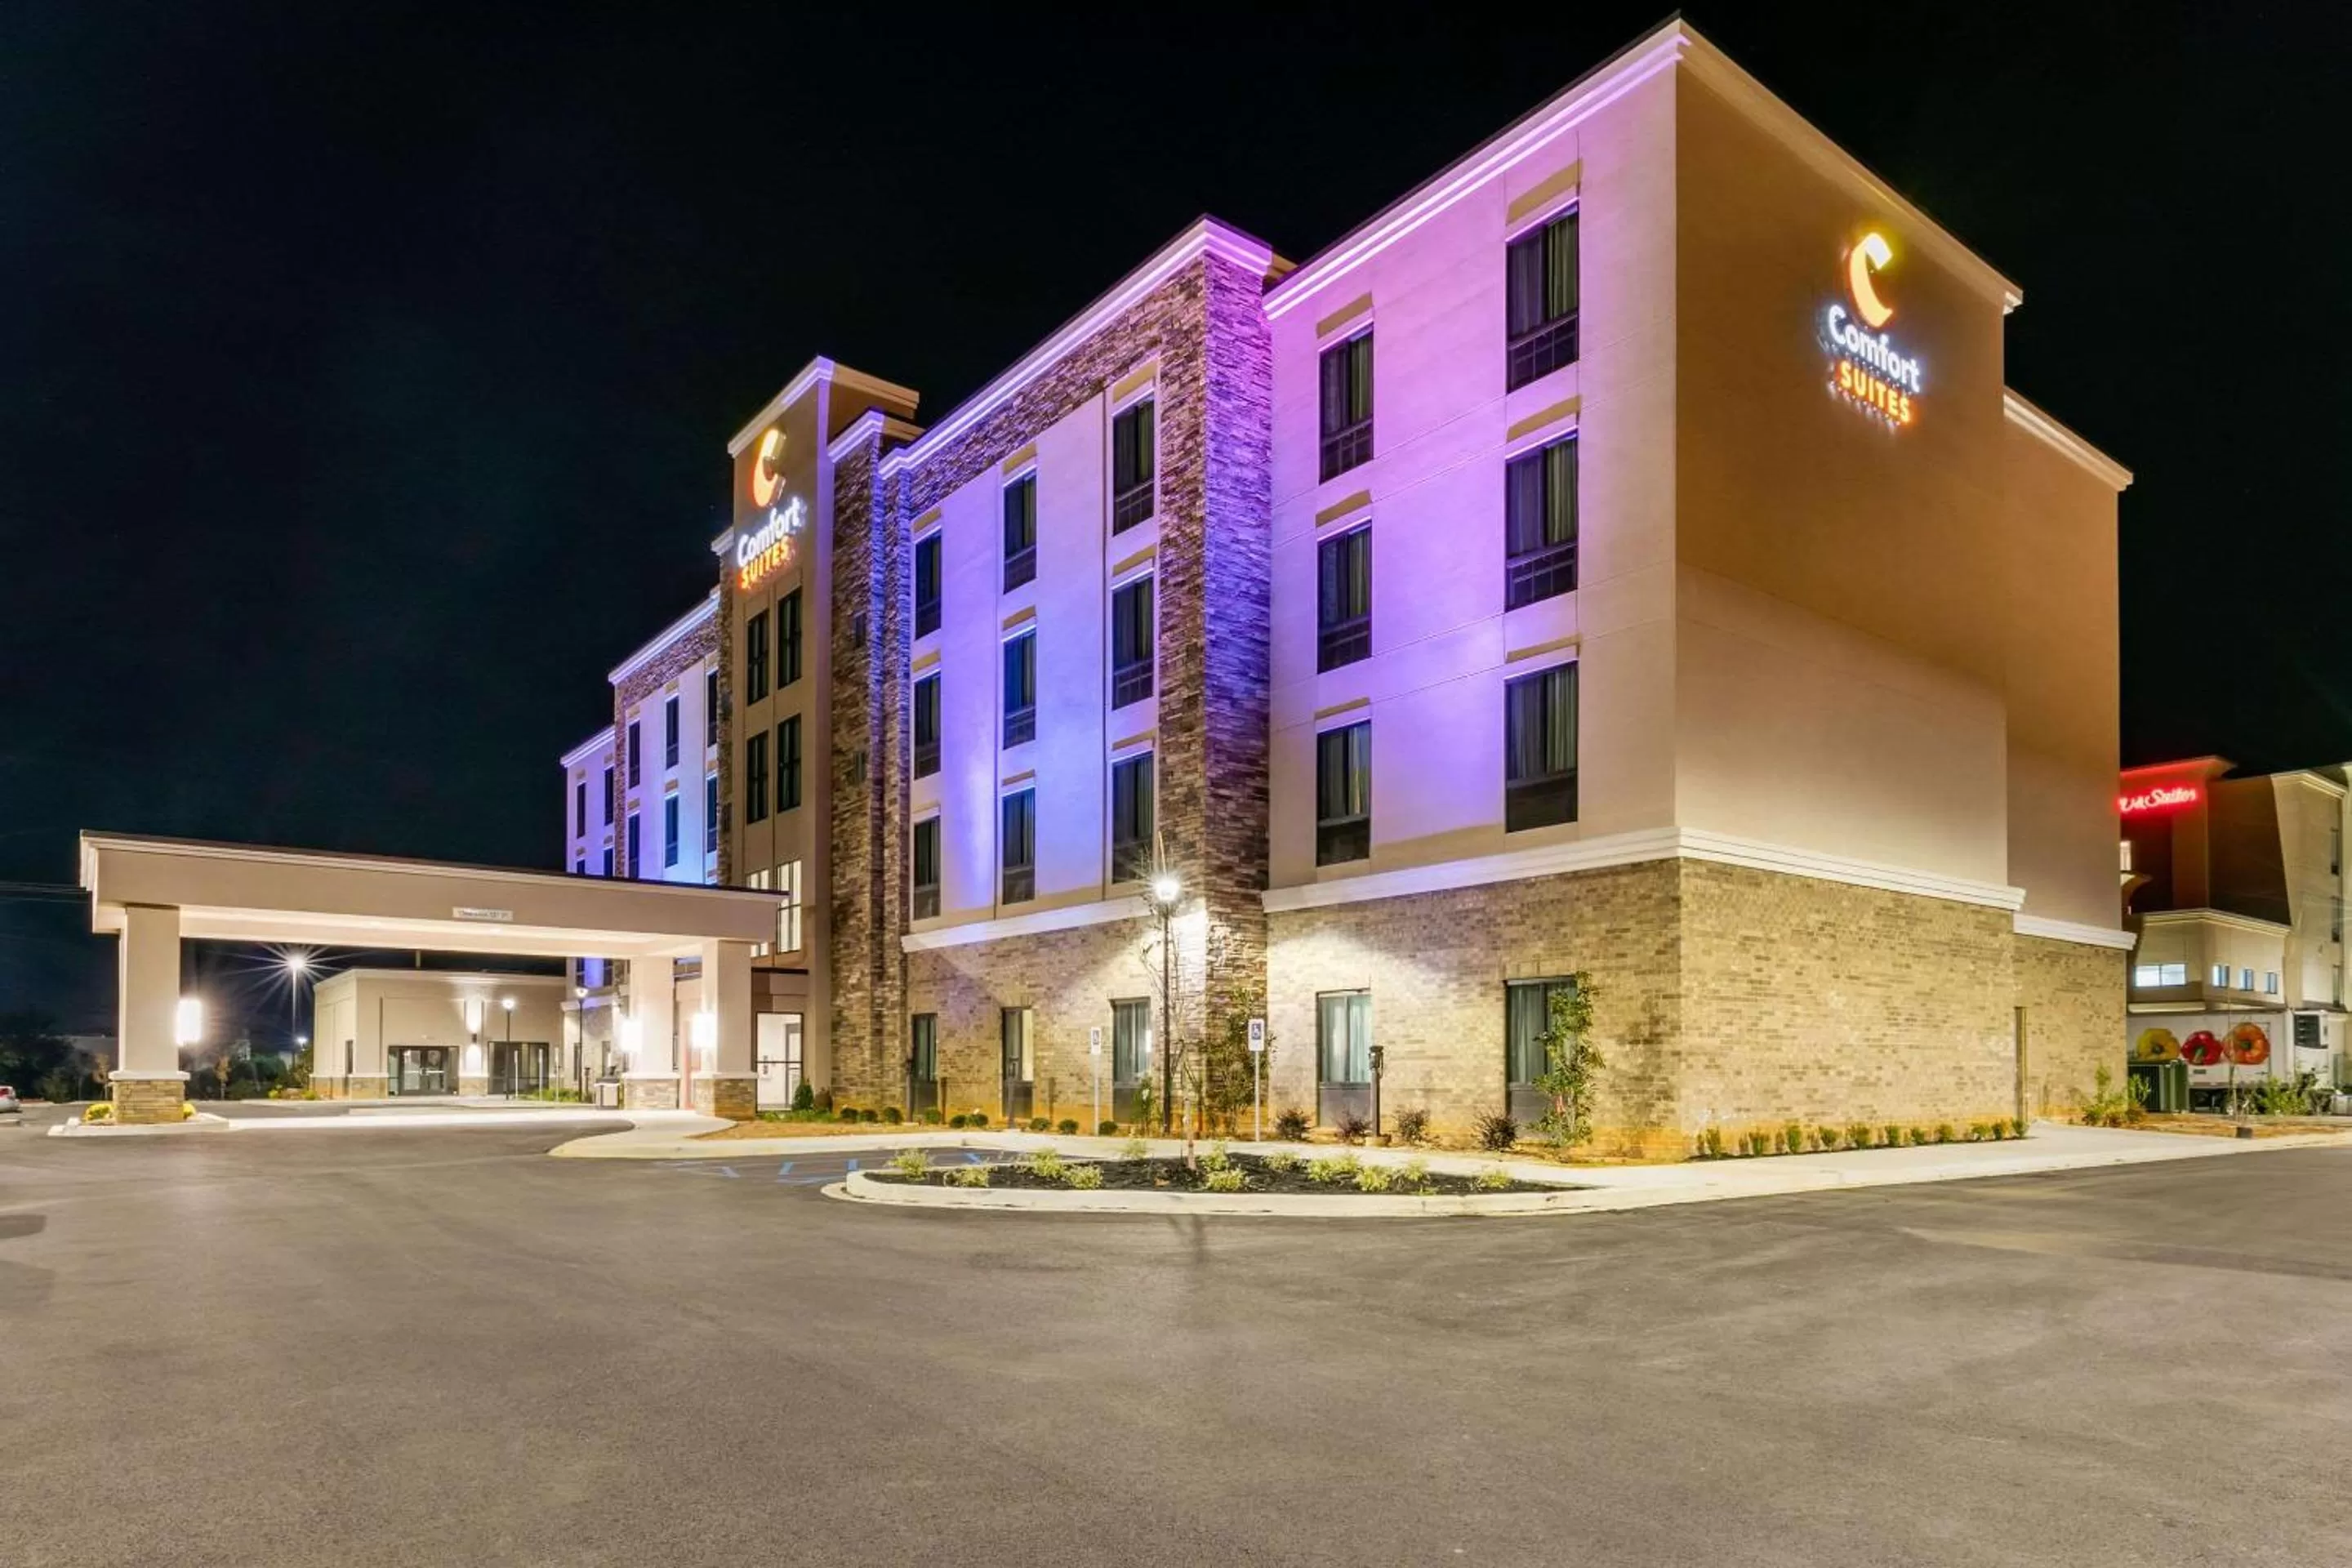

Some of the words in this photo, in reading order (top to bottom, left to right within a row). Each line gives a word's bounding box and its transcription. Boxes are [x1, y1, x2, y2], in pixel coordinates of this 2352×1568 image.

[1828, 304, 1920, 394] Comfort
[1840, 360, 1911, 423] SUITES
[737, 496, 800, 567] Comfort
[741, 535, 791, 590] SUITES
